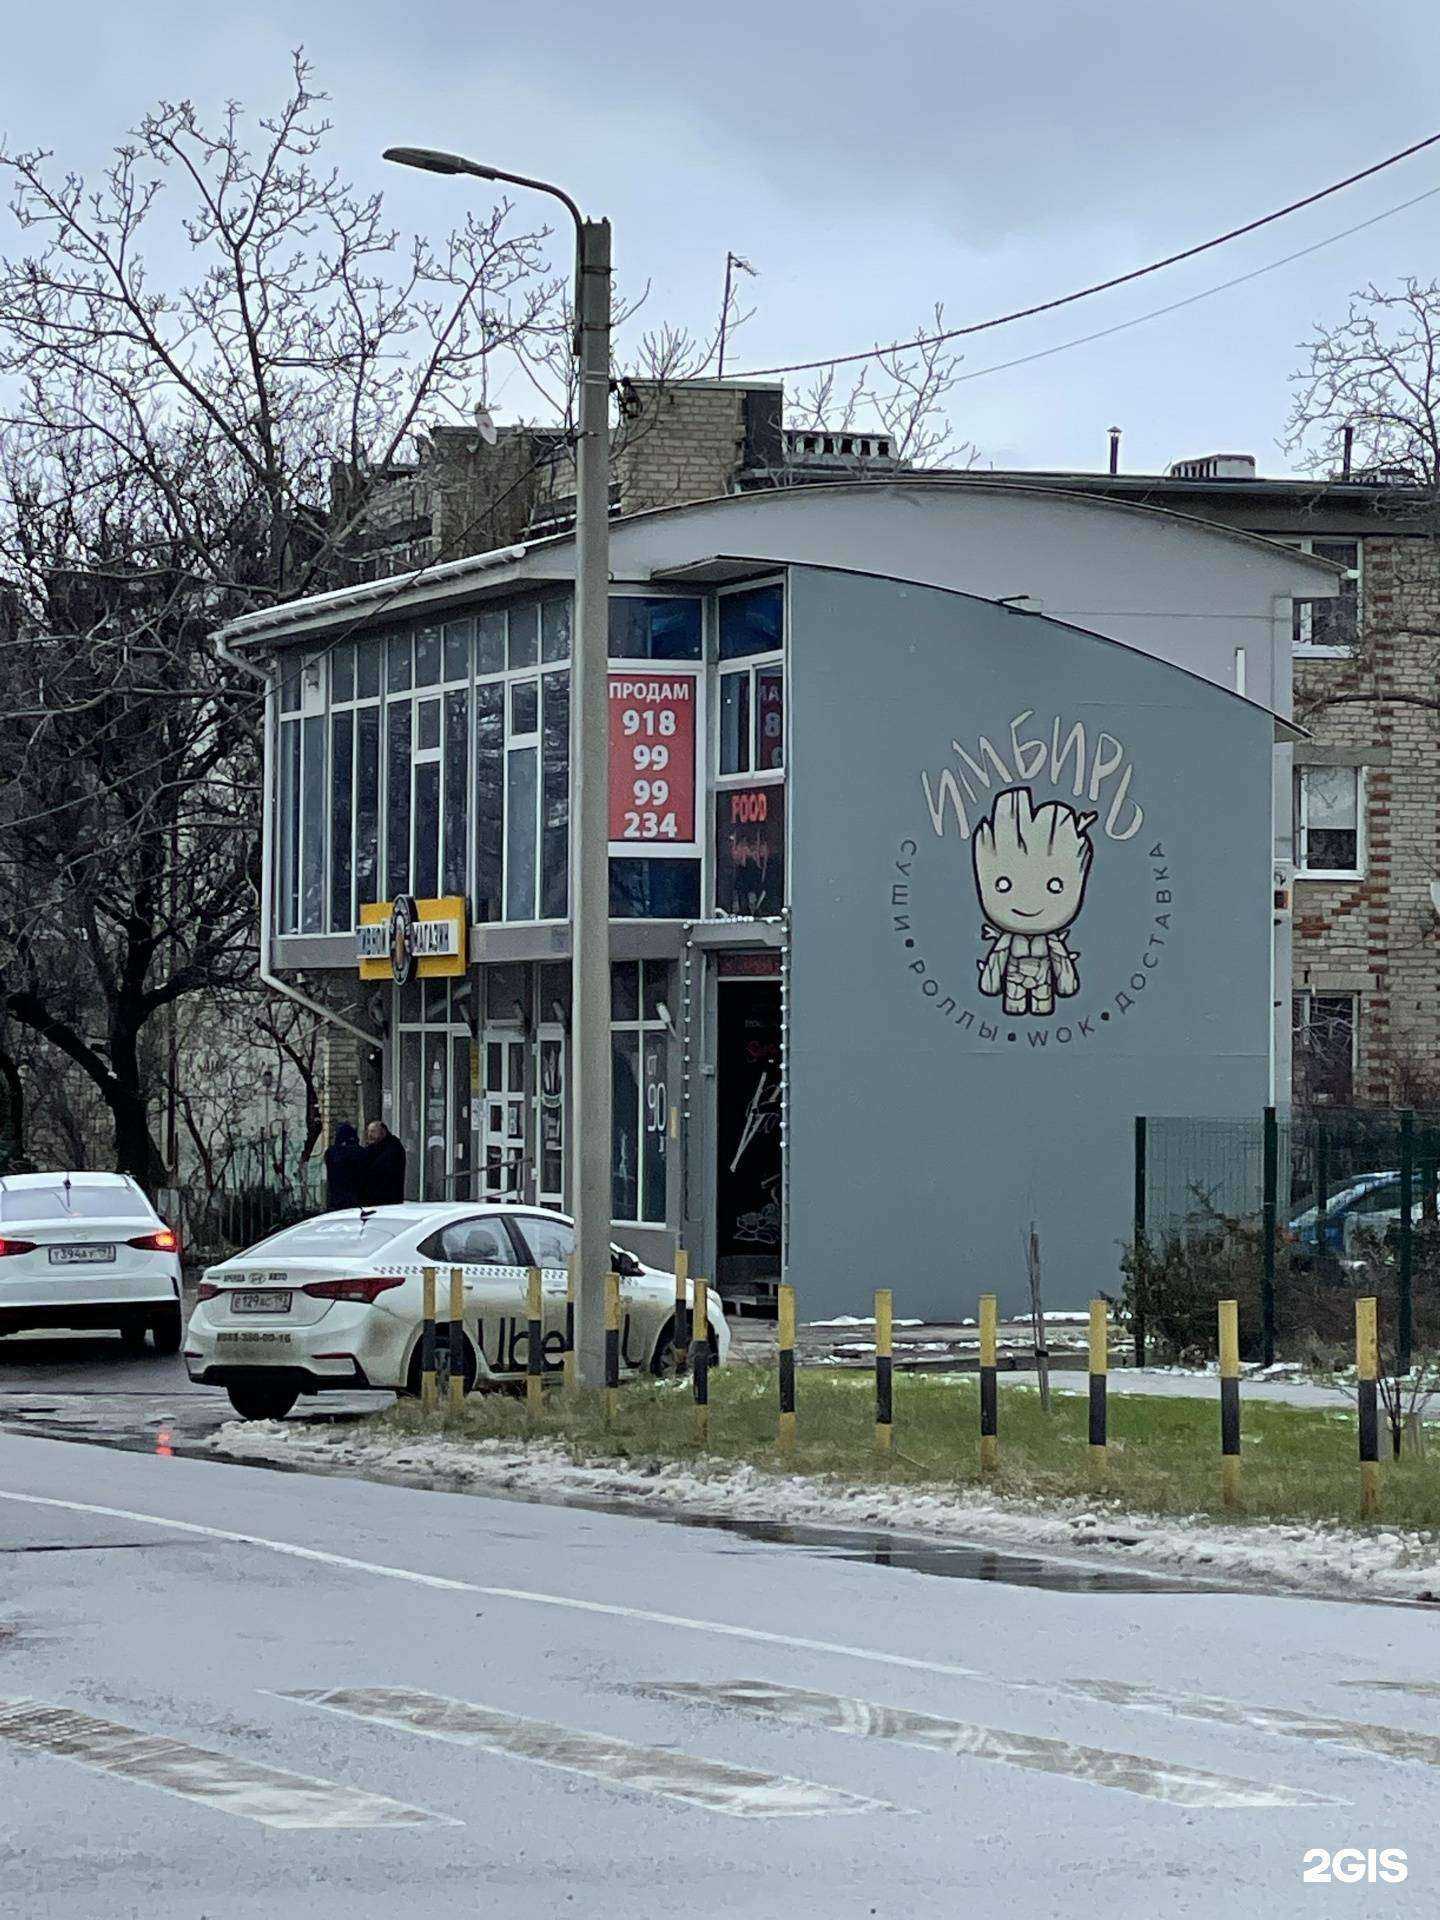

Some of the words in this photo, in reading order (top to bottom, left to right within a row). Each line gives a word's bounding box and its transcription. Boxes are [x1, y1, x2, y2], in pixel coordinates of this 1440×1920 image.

[608, 682, 690, 702] ПРОДАМ
[622, 709, 677, 736] 918
[632, 744, 669, 771] 99
[920, 709, 1144, 840] ИМБИРЬ
[632, 779, 669, 806] 99
[623, 812, 678, 838] 234
[892, 839, 918, 931] СУШИ
[909, 959, 999, 1042] РОЛЛЫ
[1027, 1020, 1096, 1047] WOK
[1114, 842, 1172, 1014] ДОСТАВКА
